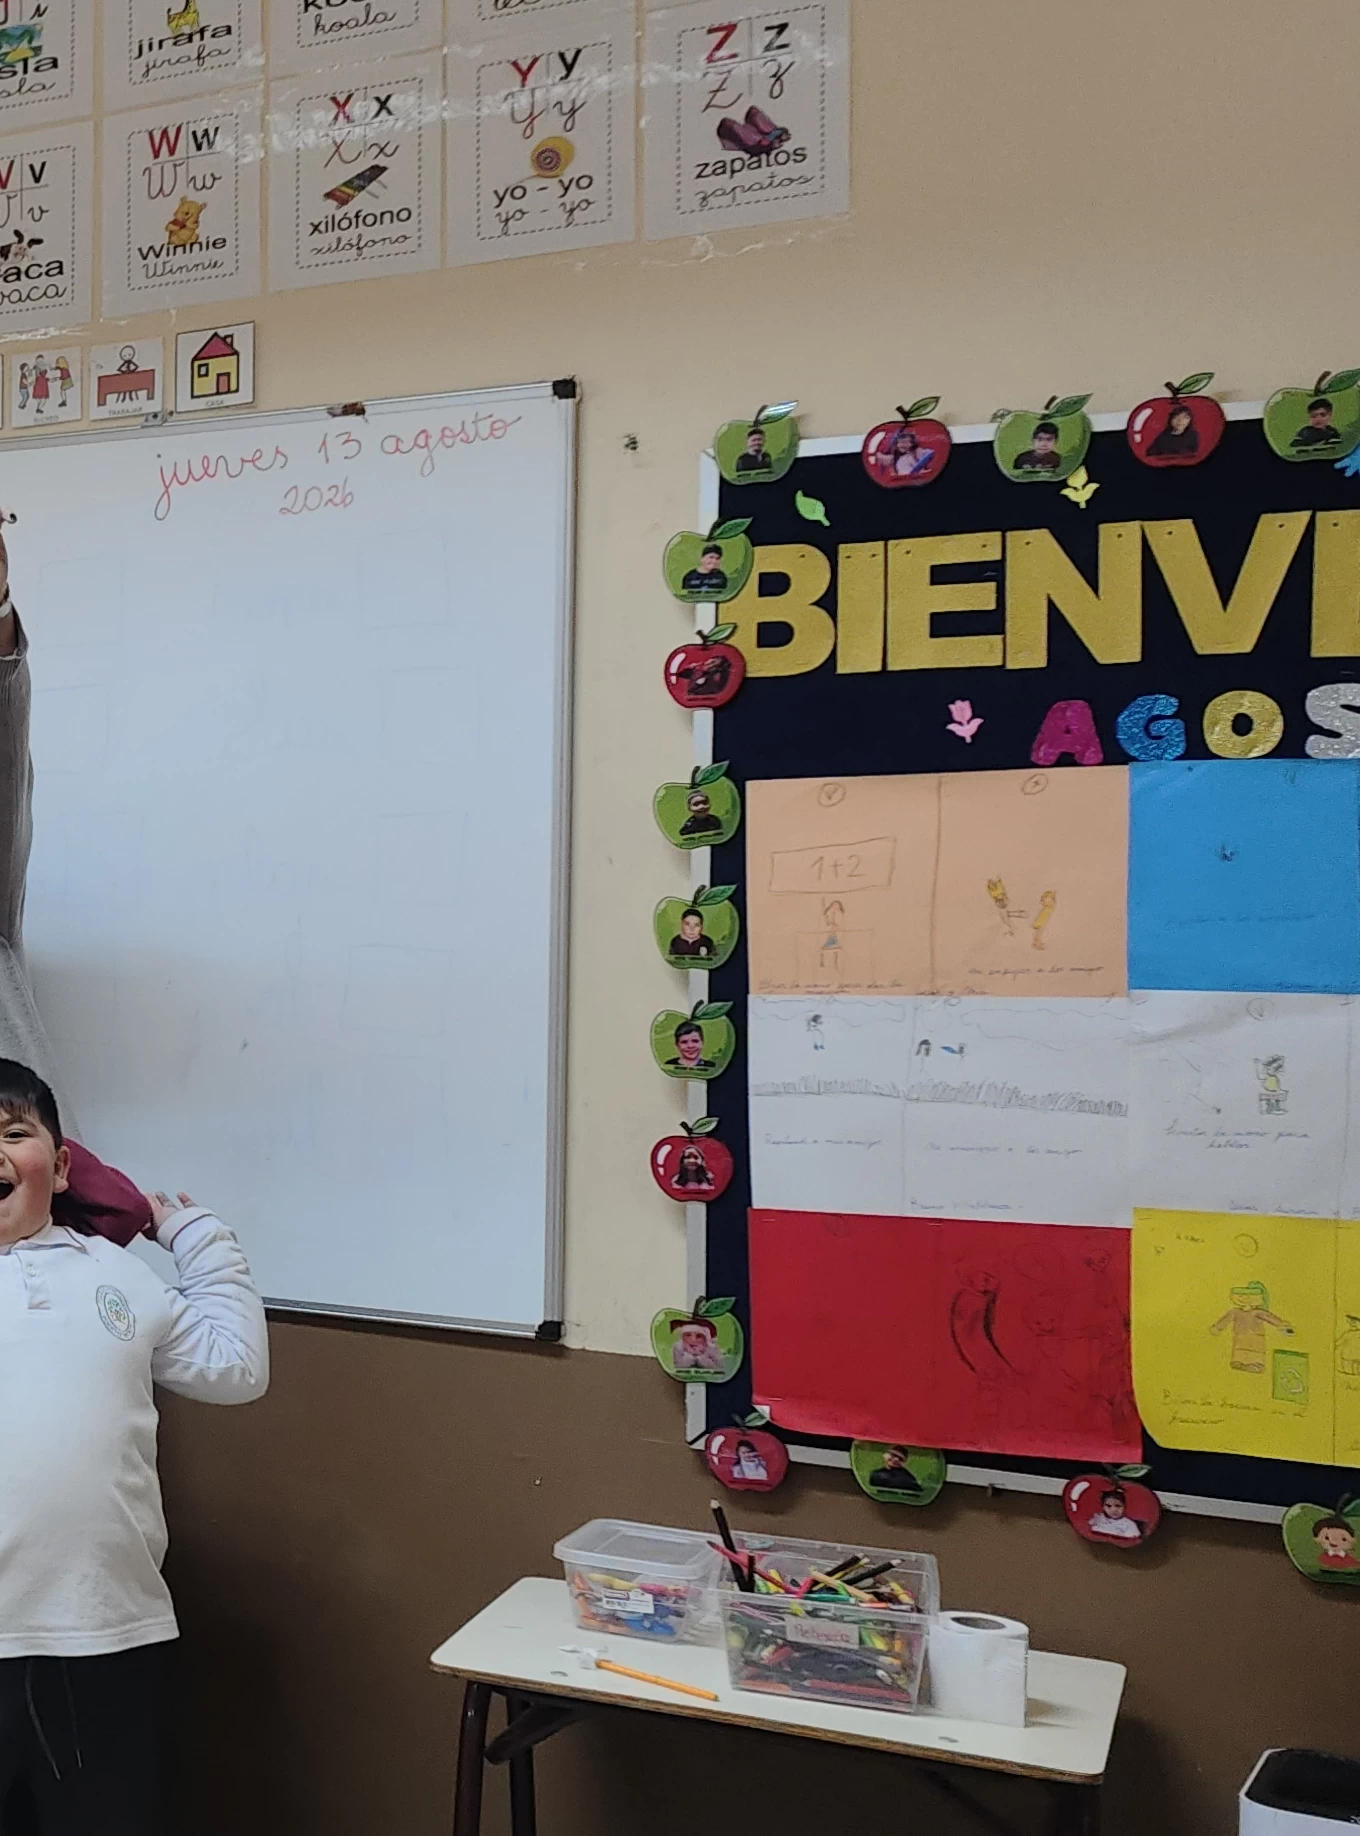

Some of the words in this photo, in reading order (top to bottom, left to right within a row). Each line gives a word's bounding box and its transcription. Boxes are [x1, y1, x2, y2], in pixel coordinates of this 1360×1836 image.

[134, 23, 232, 59] jirafa
[312, 6, 398, 41] koala
[706, 22, 739, 63] Z
[762, 22, 789, 54] z
[142, 45, 232, 79] jirafa
[694, 142, 808, 180] zapatos
[692, 172, 814, 208] zapatos
[308, 203, 412, 236] xilófono
[137, 235, 226, 261] Winnie
[310, 231, 412, 258] xilófono
[142, 258, 225, 279] Winnie
[154, 443, 289, 522] jueves
[318, 431, 362, 465] 13
[381, 416, 522, 478] agosto
[279, 477, 355, 515] 2026
